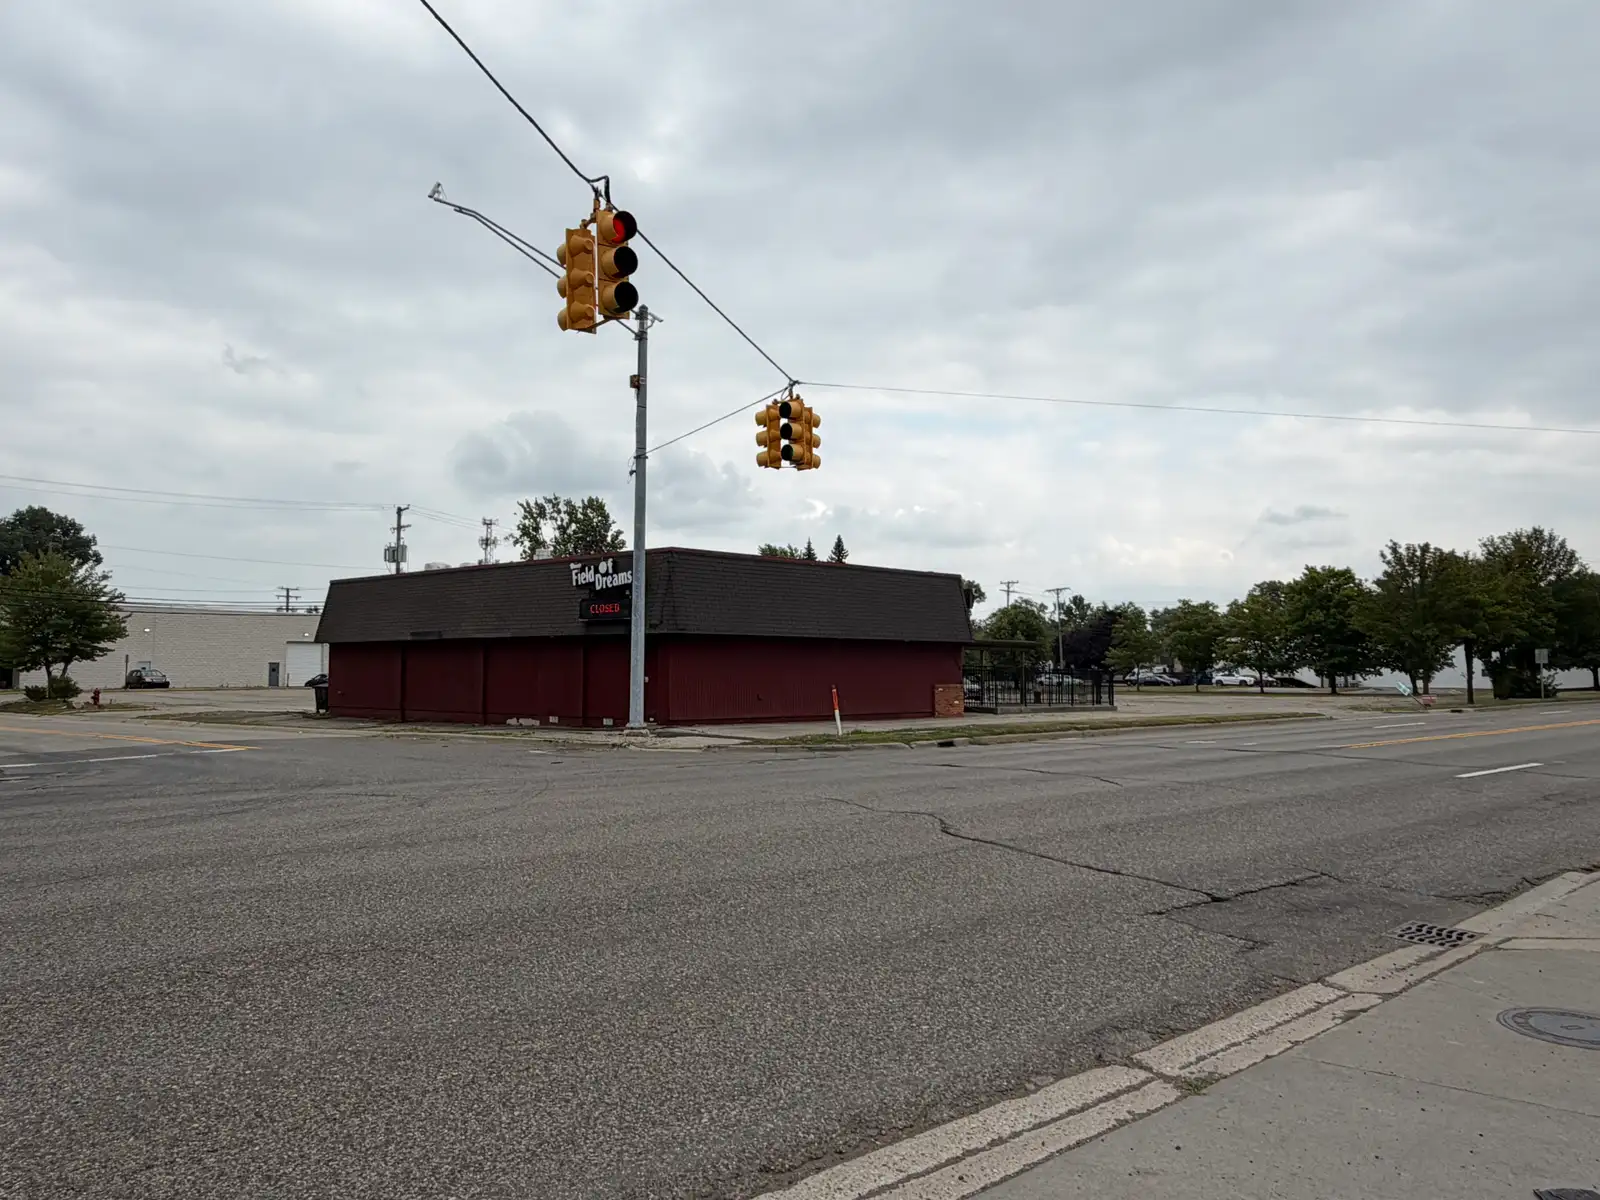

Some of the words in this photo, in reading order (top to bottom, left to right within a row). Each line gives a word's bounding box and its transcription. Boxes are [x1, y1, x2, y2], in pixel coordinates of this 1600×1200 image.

[572, 565, 595, 586] Field
[595, 570, 632, 590] Dreams
[590, 603, 620, 613] CLOSED
